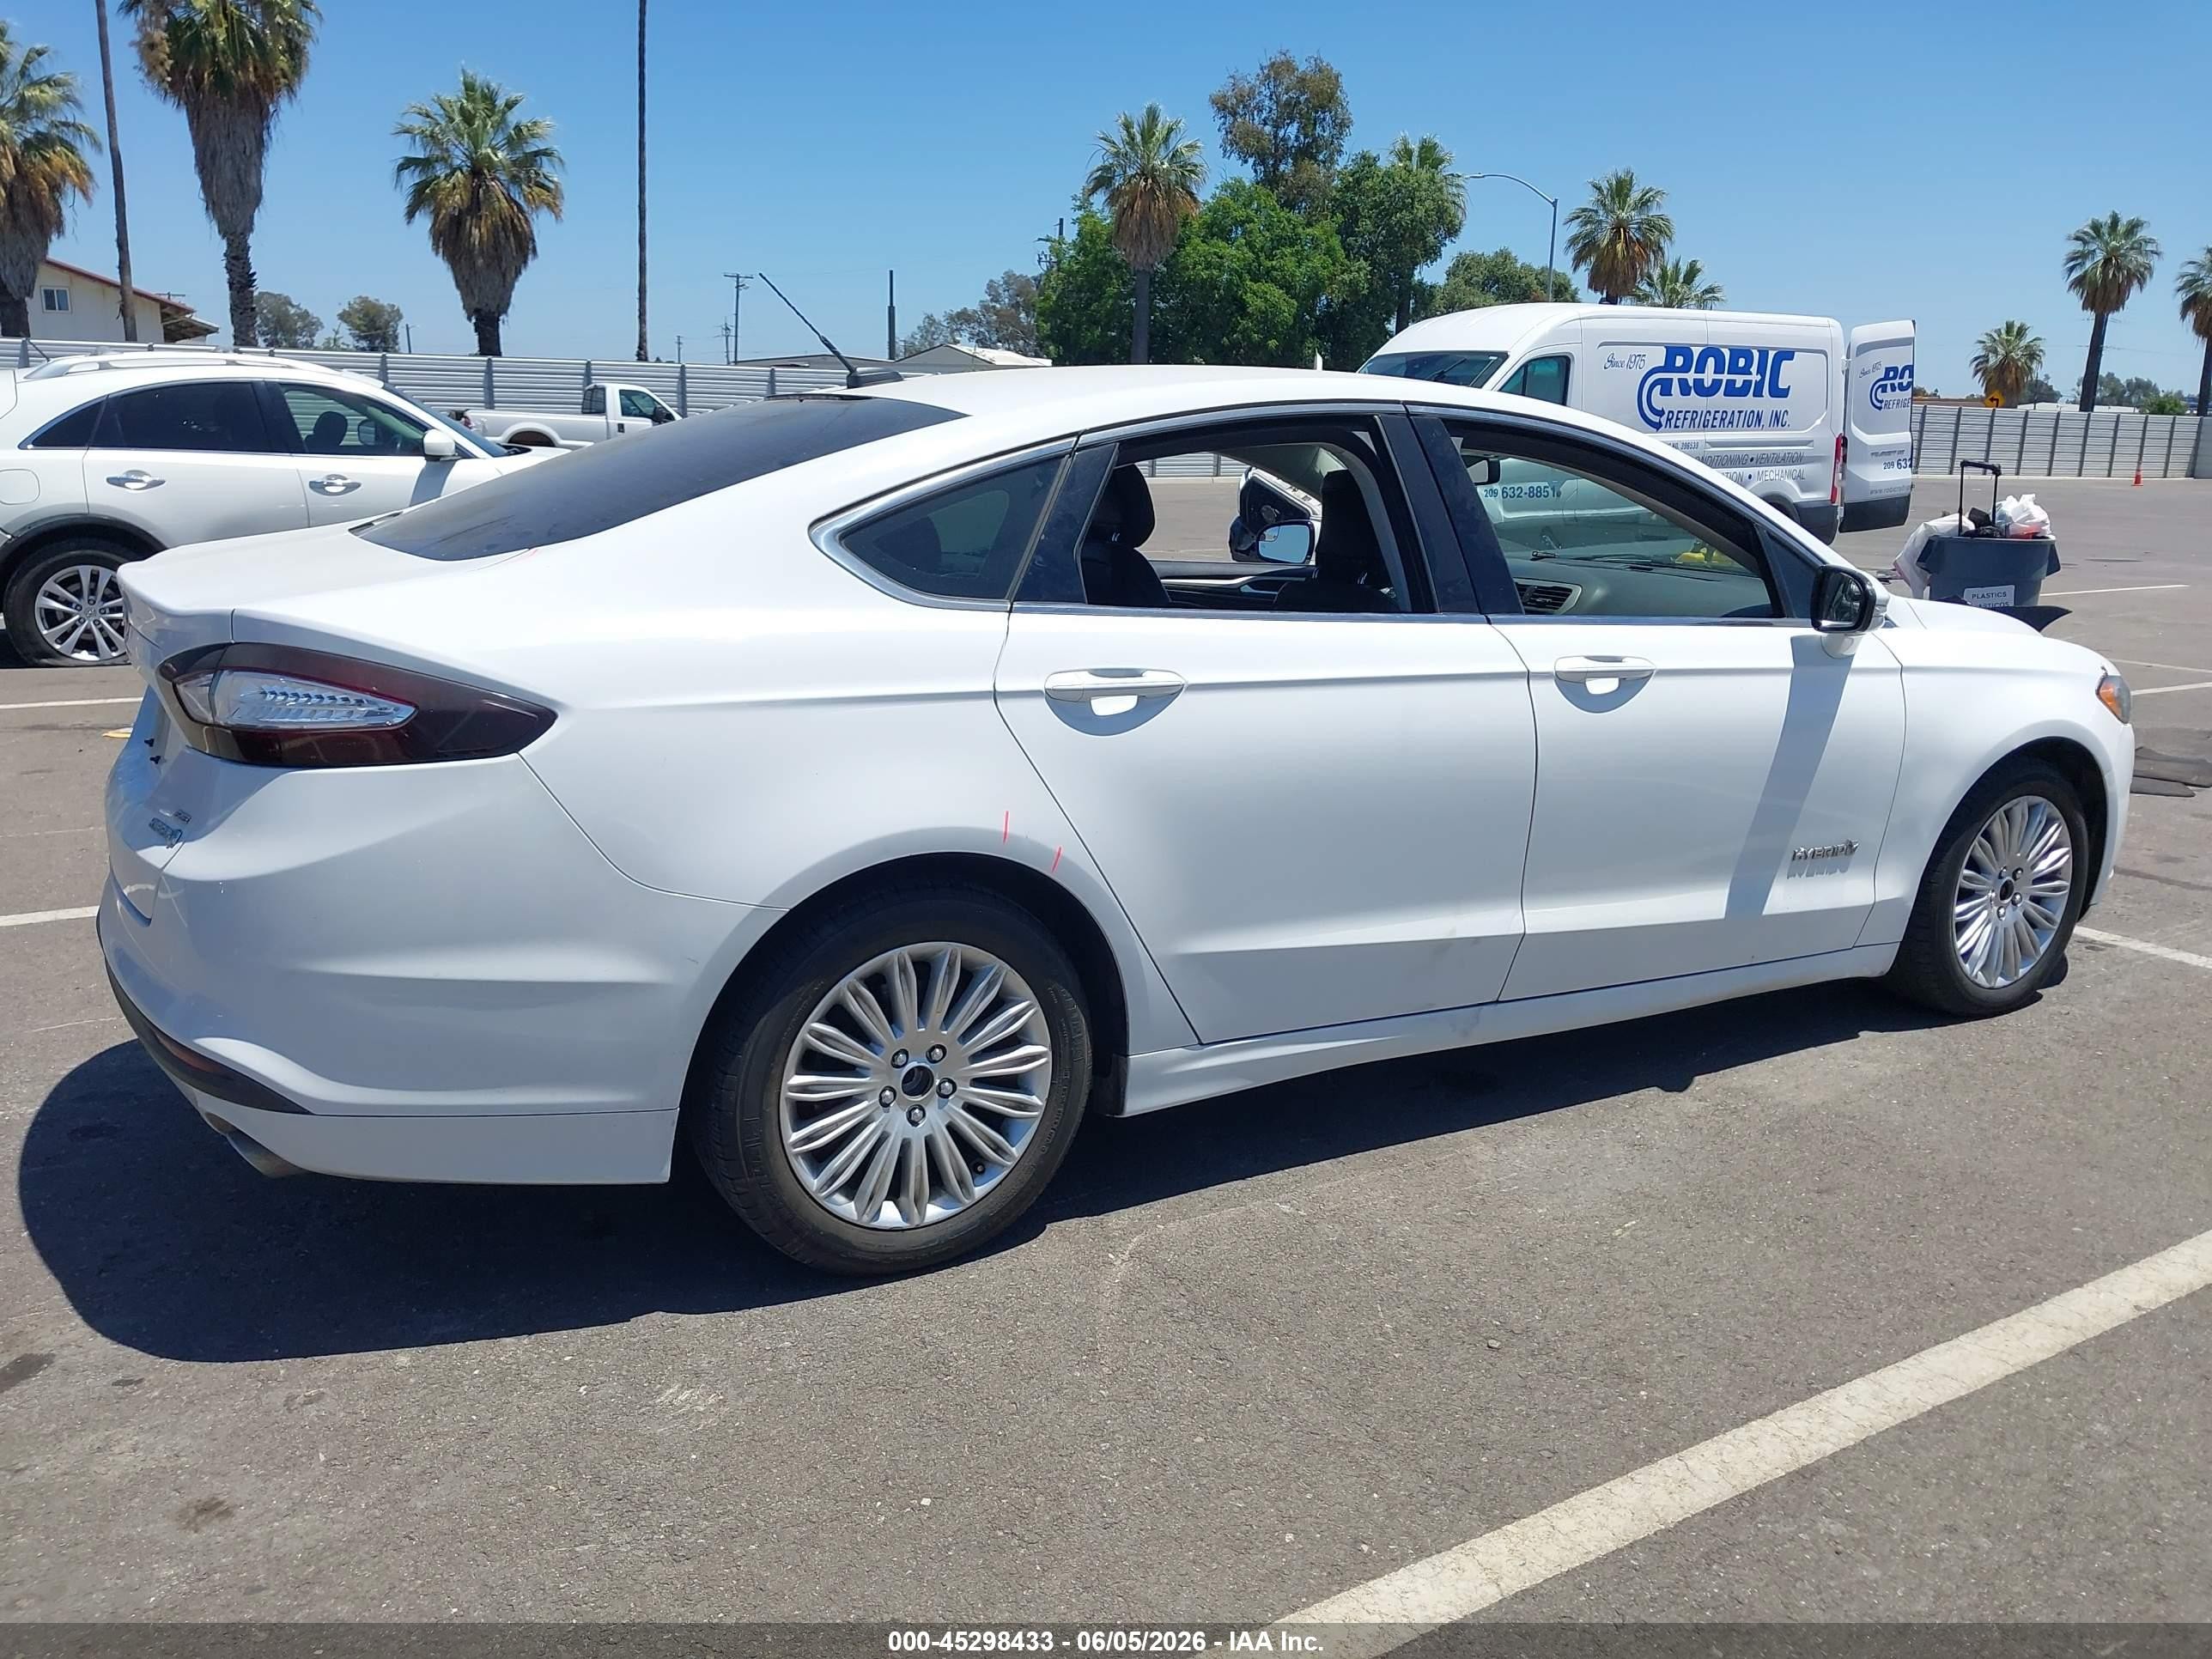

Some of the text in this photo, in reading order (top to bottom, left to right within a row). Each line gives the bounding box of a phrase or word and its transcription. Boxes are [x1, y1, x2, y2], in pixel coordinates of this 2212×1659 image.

[1603, 352, 1647, 370] Since 1975
[1658, 345, 1796, 398] ROBIC
[1664, 409, 1791, 429] REFRIGERATION, INC.
[1755, 452, 1804, 465] VENTILATION
[1882, 461, 1895, 470] 209
[1756, 468, 1806, 481] MECHANICAL
[1484, 485, 1555, 498] 209 632-8851
